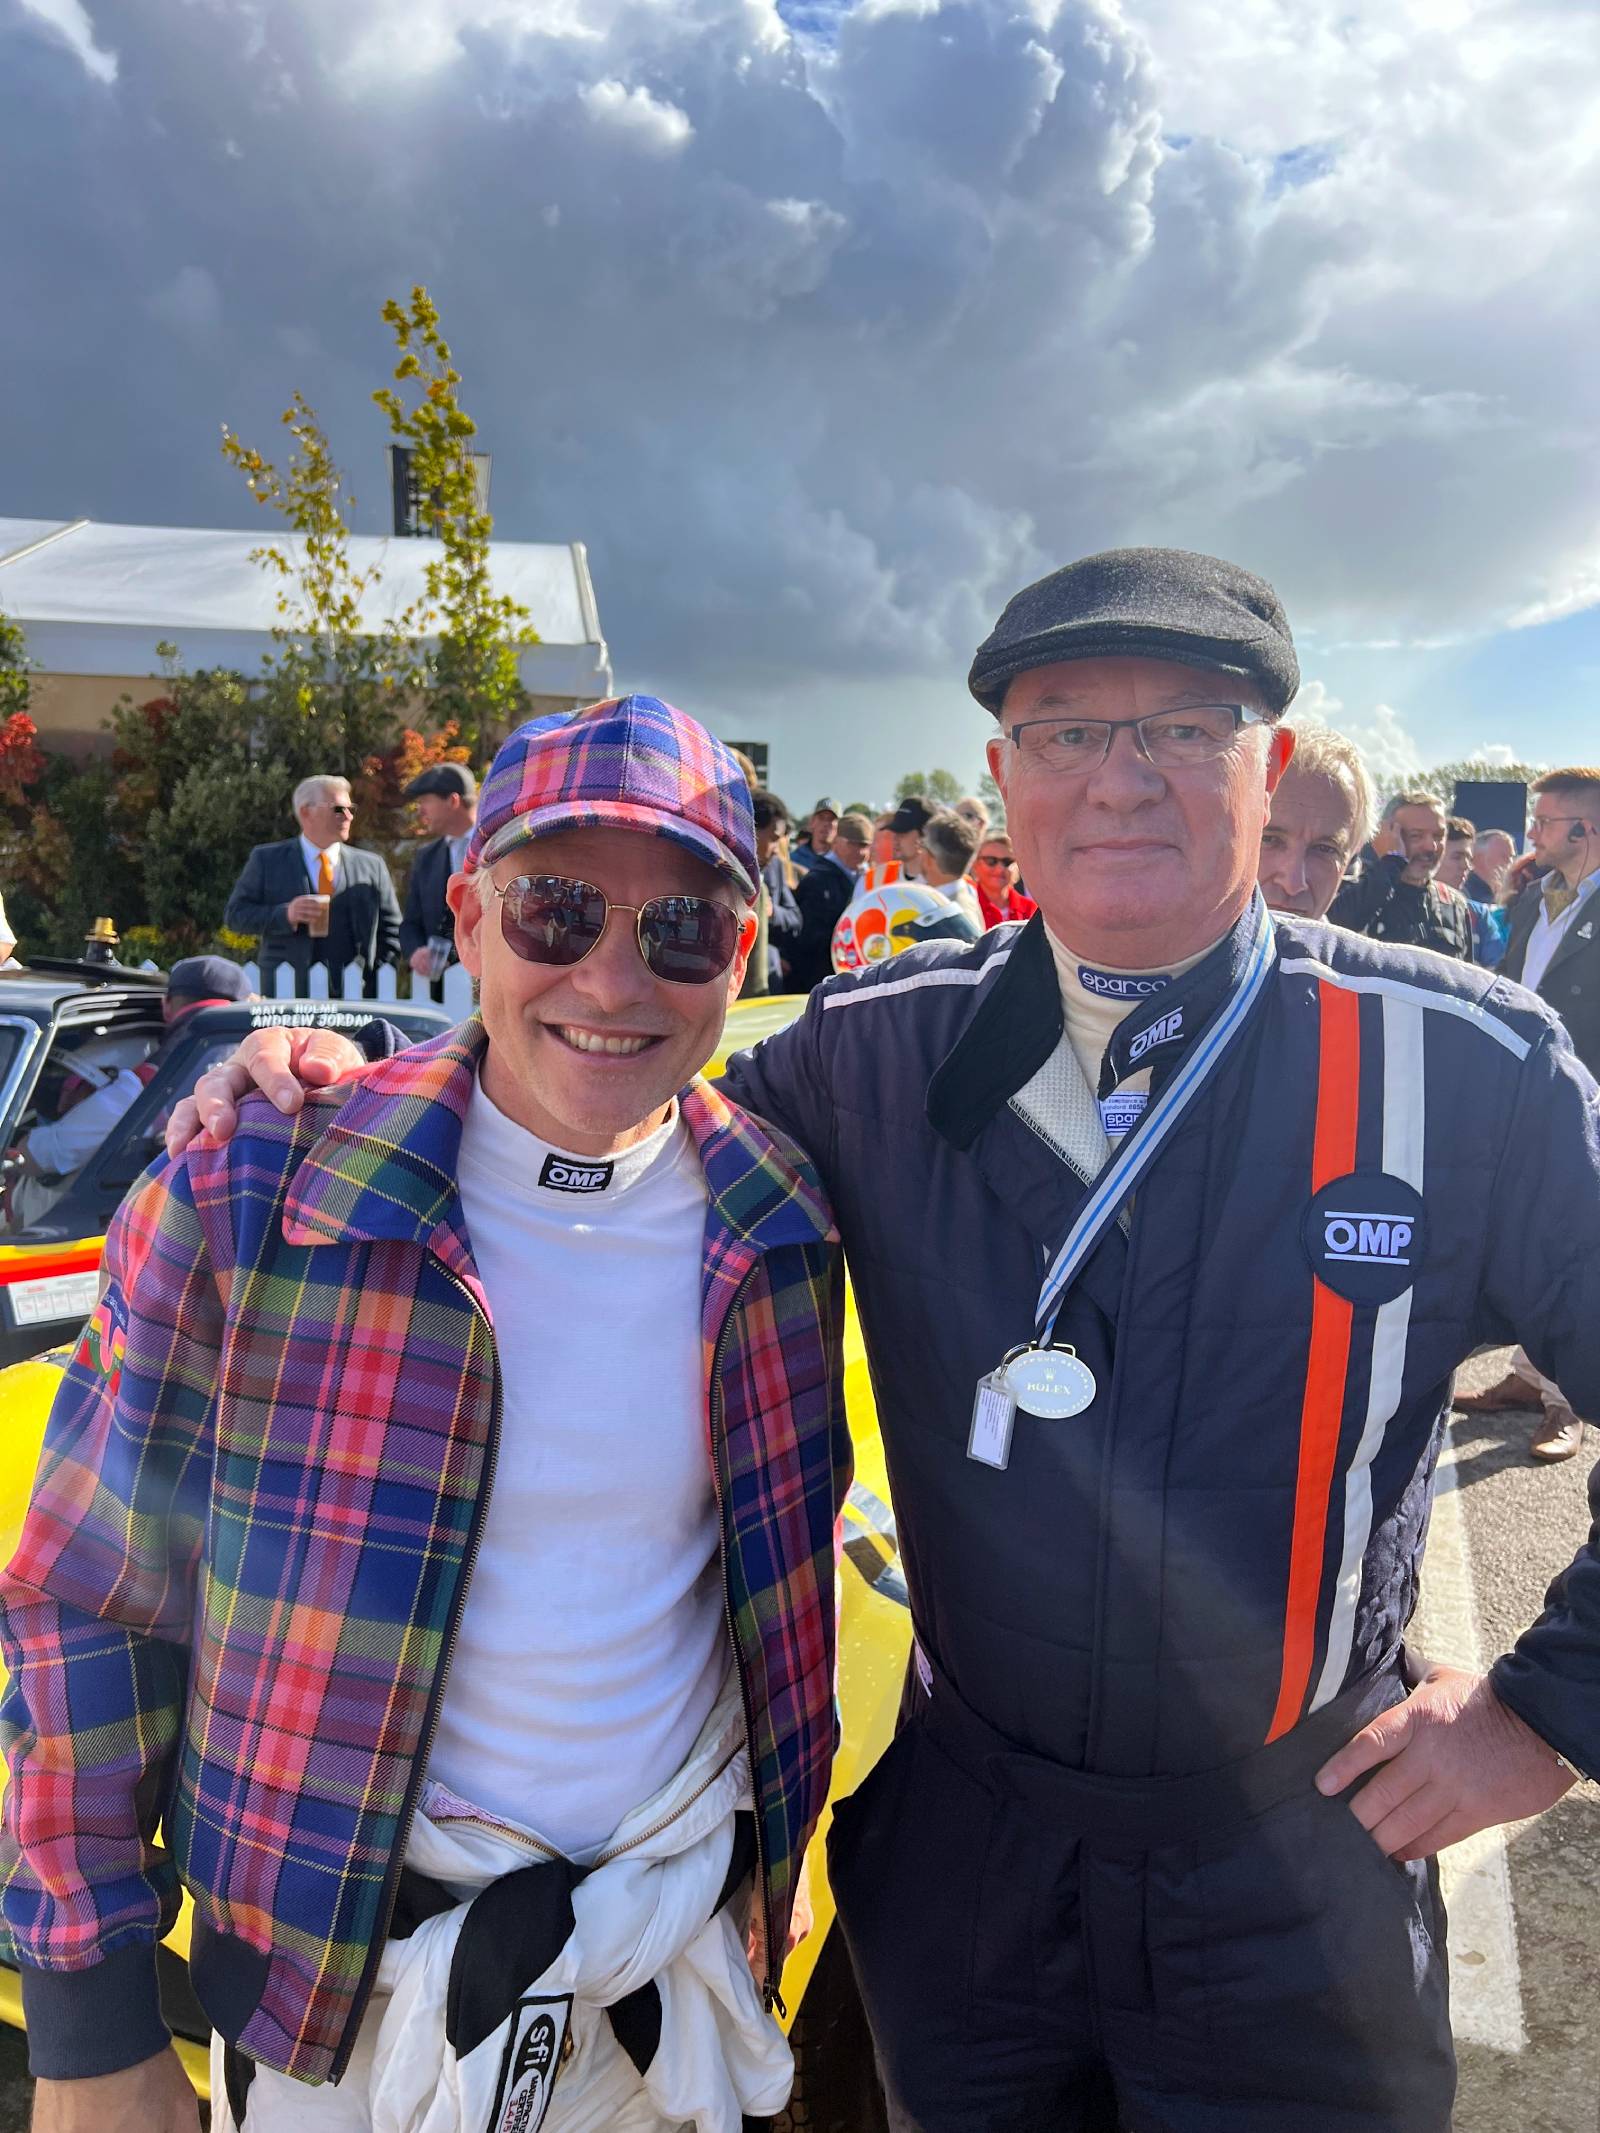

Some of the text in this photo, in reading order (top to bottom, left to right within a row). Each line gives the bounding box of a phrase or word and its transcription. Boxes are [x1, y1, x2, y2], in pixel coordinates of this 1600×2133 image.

[1082, 972, 1167, 994] sparco
[250, 1005, 286, 1015] MATT
[252, 1013, 373, 1027] ANDREW JORDAN
[1129, 1013, 1183, 1057] OMP
[1107, 1114, 1139, 1126] spar
[549, 1167, 606, 1187] OMP
[1325, 1219, 1412, 1257] OMP
[1027, 1382, 1072, 1396] ROLEX
[524, 2025, 549, 2066] sfi
[510, 2089, 528, 2133] CERTIFIE
[519, 2074, 540, 2133] MANUFACTU
